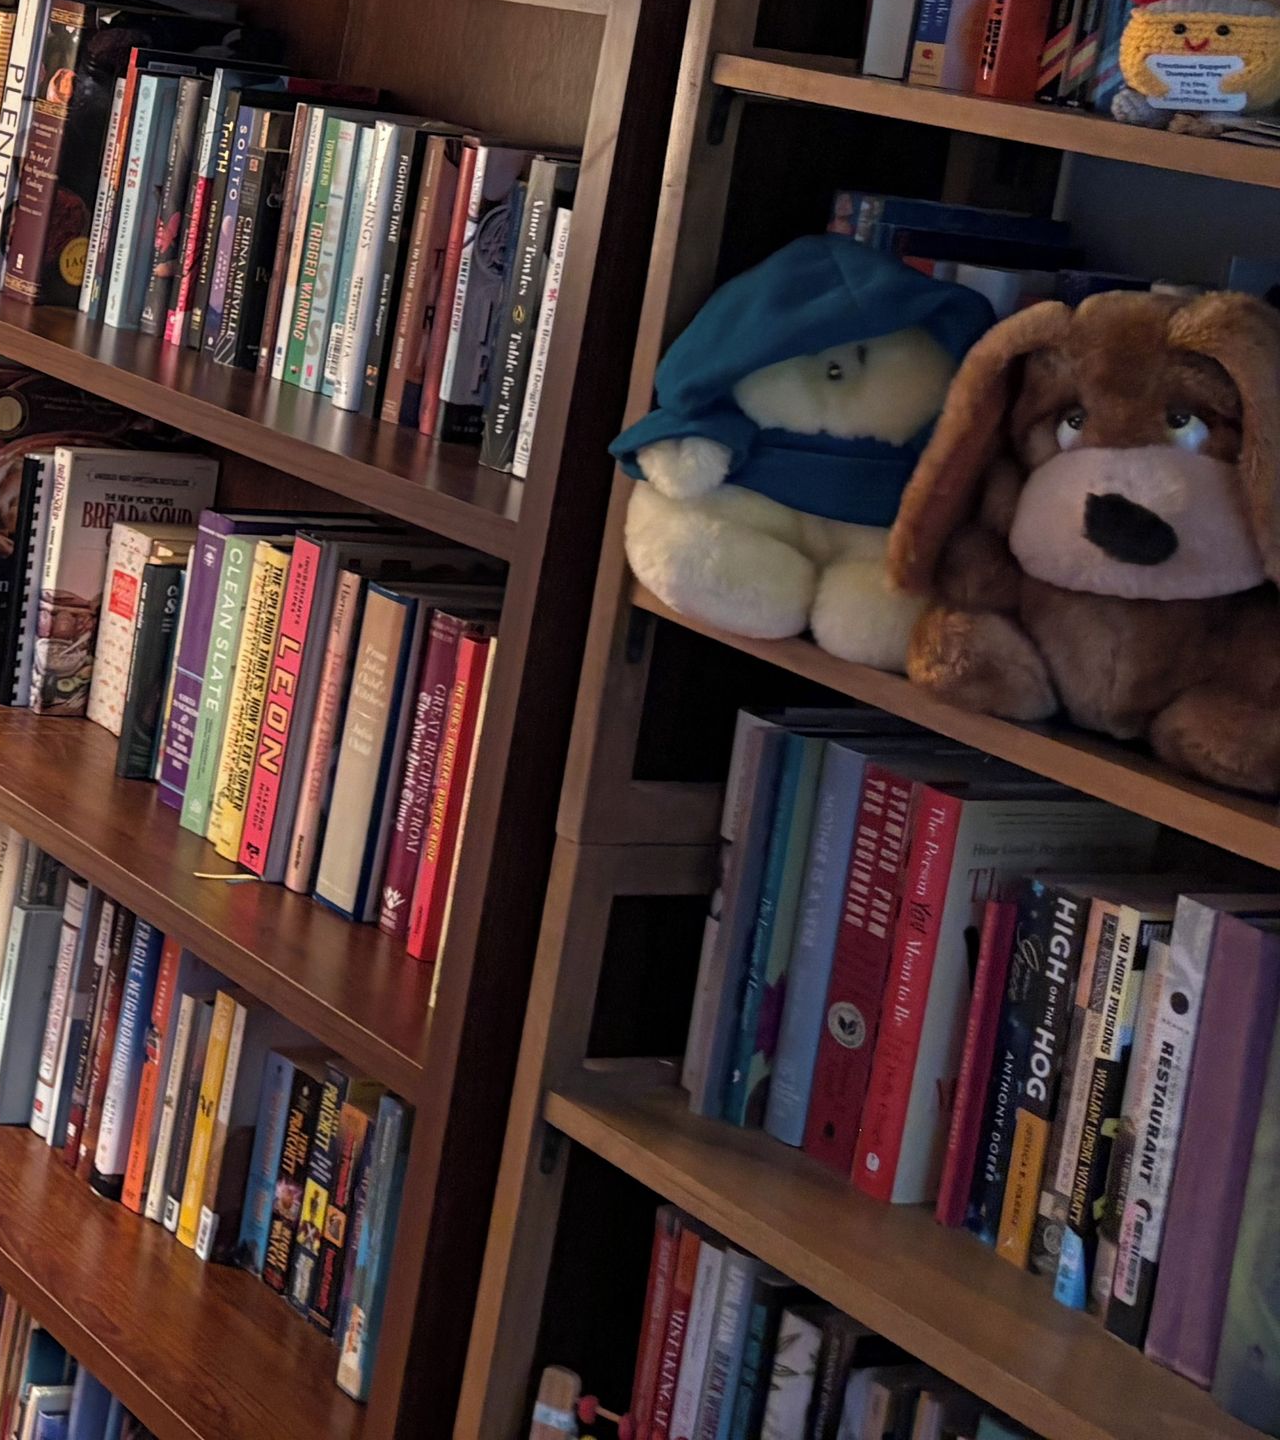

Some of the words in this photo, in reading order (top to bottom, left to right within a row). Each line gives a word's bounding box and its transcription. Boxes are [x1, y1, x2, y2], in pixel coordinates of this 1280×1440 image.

[125, 154, 140, 189] YES
[227, 124, 248, 201] SOLITO
[319, 138, 336, 185] TOWNSEND
[389, 154, 410, 212] FIGHTING
[231, 215, 245, 256] Perdido
[236, 216, 254, 266] CHINA
[386, 214, 400, 242] TIME
[526, 199, 545, 240] Amor
[302, 220, 324, 276] TRIGGER
[411, 247, 419, 258] IN
[516, 243, 538, 296] Towles
[225, 260, 237, 293] Street
[406, 259, 418, 288] YOUR
[457, 257, 469, 285] INNER
[551, 262, 561, 283] GAY
[218, 297, 232, 336] Station
[224, 270, 247, 340] MIÉVILLE
[291, 281, 314, 341] WARNING
[449, 287, 464, 333] ANARCHY
[542, 306, 553, 326] The
[503, 330, 523, 373] Table
[537, 328, 550, 357] Book
[499, 374, 516, 400] for
[534, 359, 544, 372] of
[525, 374, 542, 417] Delights
[493, 401, 511, 435] Two
[81, 501, 141, 528] BREAD
[216, 546, 243, 632] CLEAN
[270, 566, 284, 588] THE
[289, 571, 302, 613] RECIPES
[293, 556, 310, 625] INGREDIENTS
[259, 589, 280, 647] SPLENDID
[204, 636, 229, 712] SLATE
[455, 679, 465, 700] THE
[246, 697, 261, 724] HOW
[256, 633, 303, 776] LEON
[414, 691, 432, 719] The
[425, 684, 448, 737] GREAT
[448, 703, 461, 733] BOB'S
[239, 742, 253, 764] EAT
[243, 725, 256, 741] TO
[409, 717, 427, 747] New
[399, 748, 421, 788] York
[413, 739, 438, 805] RECIPES
[438, 737, 454, 786] BURGERS
[231, 766, 249, 811] SUPPER
[257, 786, 270, 832] ALLEGRA
[430, 788, 446, 830] BURGER
[861, 778, 886, 815] THE
[393, 788, 414, 833] Times
[404, 806, 426, 853] FROM
[877, 785, 907, 873] STAMPED
[924, 805, 946, 839] The
[843, 825, 878, 928] BEGINNING
[914, 840, 940, 897] Person
[866, 886, 892, 939] FROM
[905, 899, 934, 934] You
[129, 921, 152, 975] FRAGILE
[898, 939, 921, 982] Mean
[1043, 896, 1077, 985] HIGH
[1118, 933, 1131, 952] NO
[895, 984, 913, 1002] to
[1046, 985, 1057, 1002] ON
[1110, 955, 1127, 994] MORE
[110, 979, 143, 1087] NEIGHBORHOODS
[891, 1004, 910, 1027] Be
[1042, 1005, 1054, 1026] THE
[1099, 995, 1120, 1055] PRISONS
[74, 1054, 87, 1086] TEACH
[1024, 1026, 1055, 1101] HOG
[992, 1050, 1015, 1127] ANTHONY
[1085, 1068, 1109, 1125] WILLIAM
[313, 1081, 339, 1151] PRATCHETT
[1137, 1041, 1175, 1185] RESTAURANT
[277, 1108, 306, 1174] PRATCHETT
[983, 1132, 1001, 1182] DOERR
[1078, 1125, 1097, 1163] UPSKI
[1066, 1165, 1091, 1225] WIMSATT
[264, 1219, 285, 1266] WATCH
[274, 1226, 294, 1271] NIGHT
